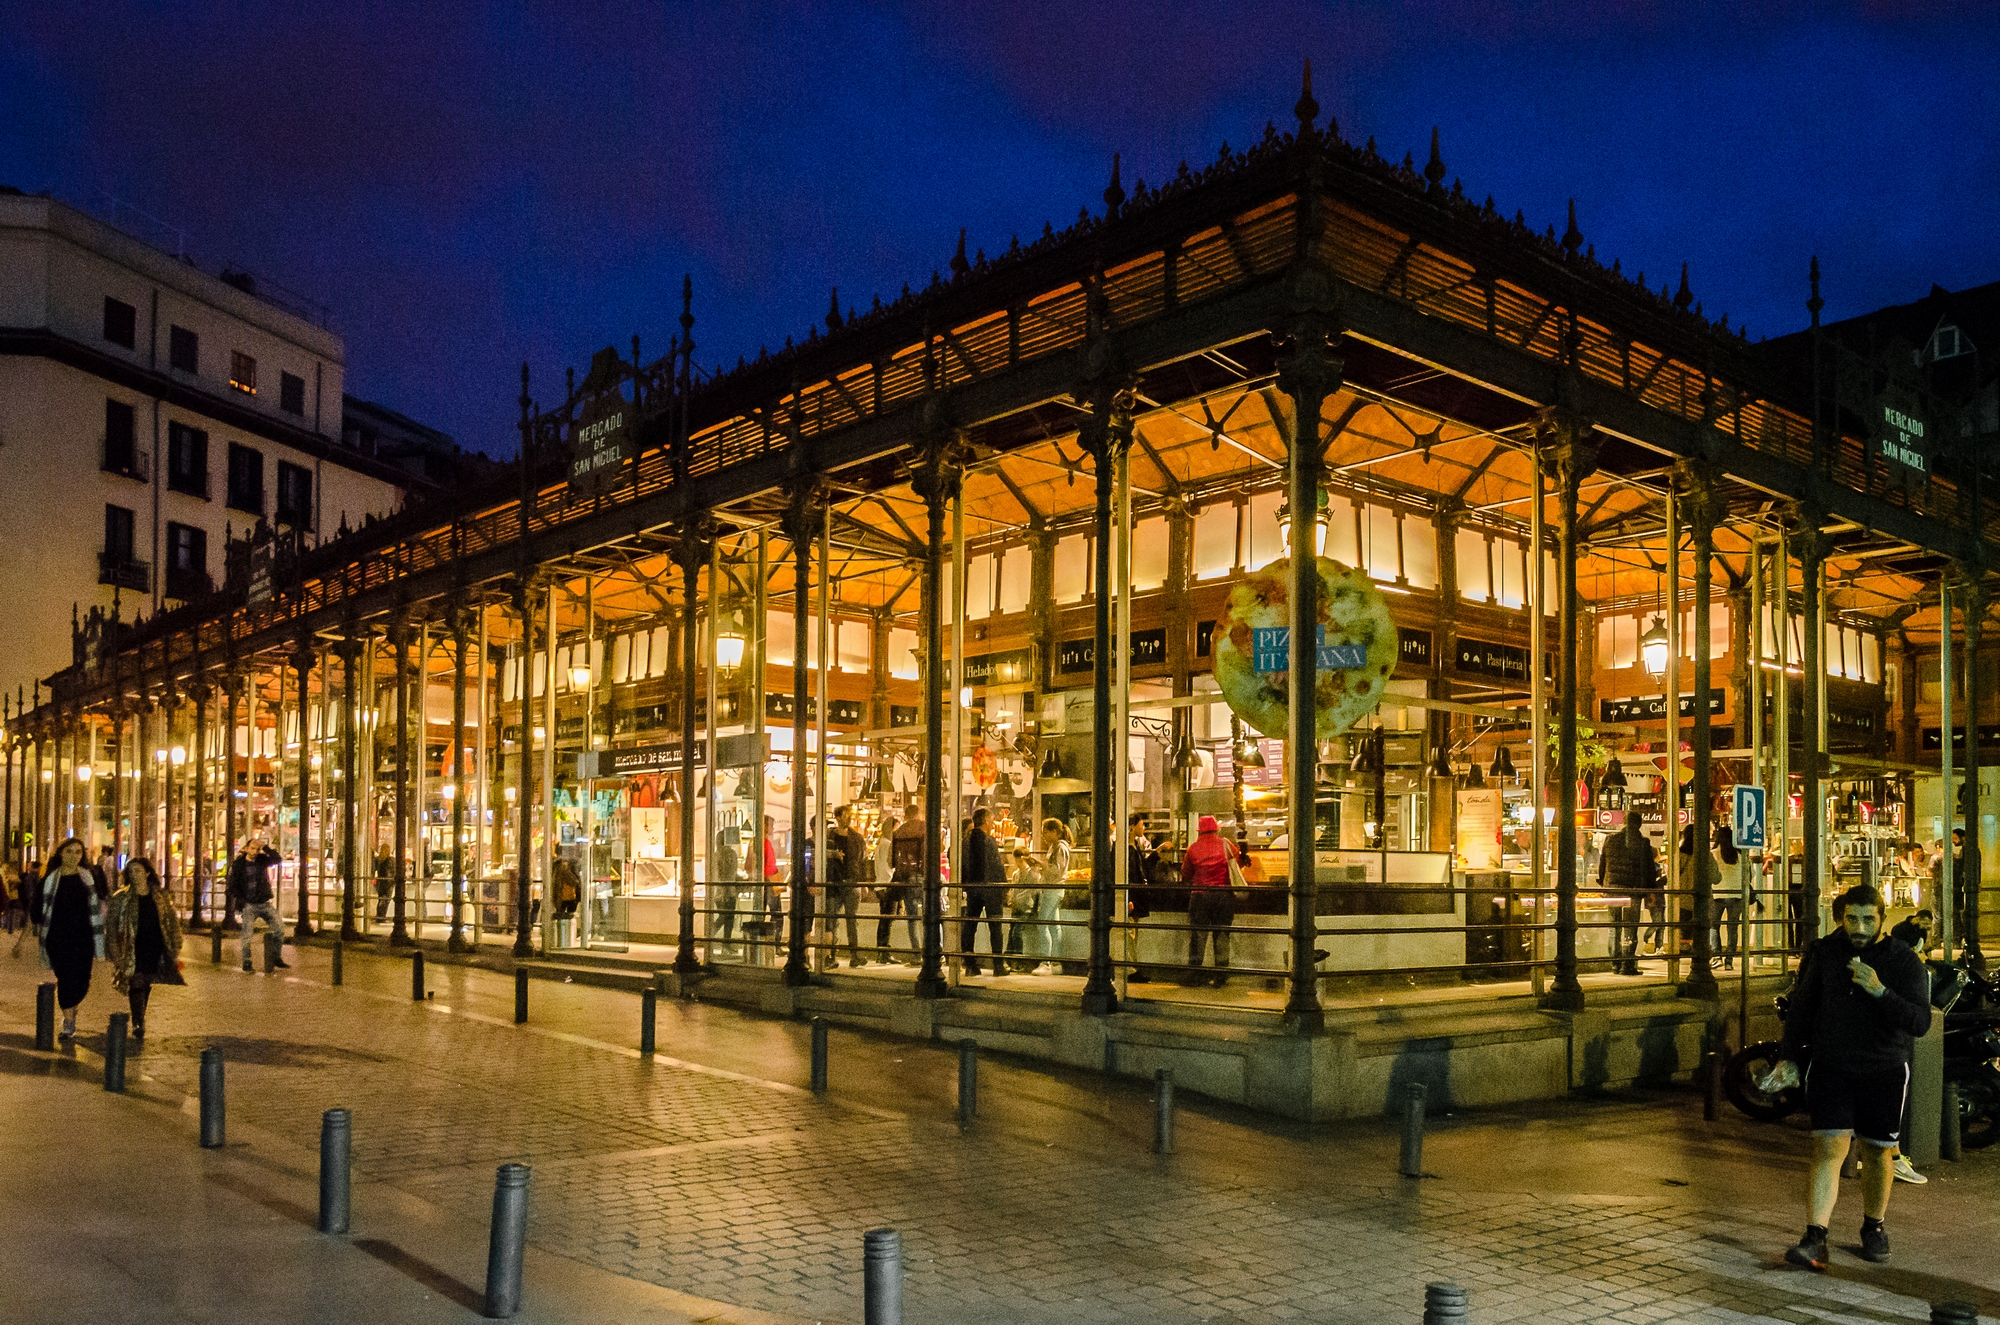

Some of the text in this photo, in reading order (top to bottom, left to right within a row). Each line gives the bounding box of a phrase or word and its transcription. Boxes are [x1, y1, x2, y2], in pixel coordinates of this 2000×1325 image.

[578, 411, 623, 444] MERCADO
[1885, 406, 1924, 438] MERCADO
[593, 436, 606, 451] DE
[1899, 431, 1911, 446] DE
[574, 444, 623, 477] SAN MIGUEL
[1882, 439, 1926, 472] SAN MIGUEL
[1259, 647, 1364, 670] ITAANA
[1649, 702, 1667, 714] Caf
[658, 750, 672, 763] san
[1742, 791, 1757, 840] P
